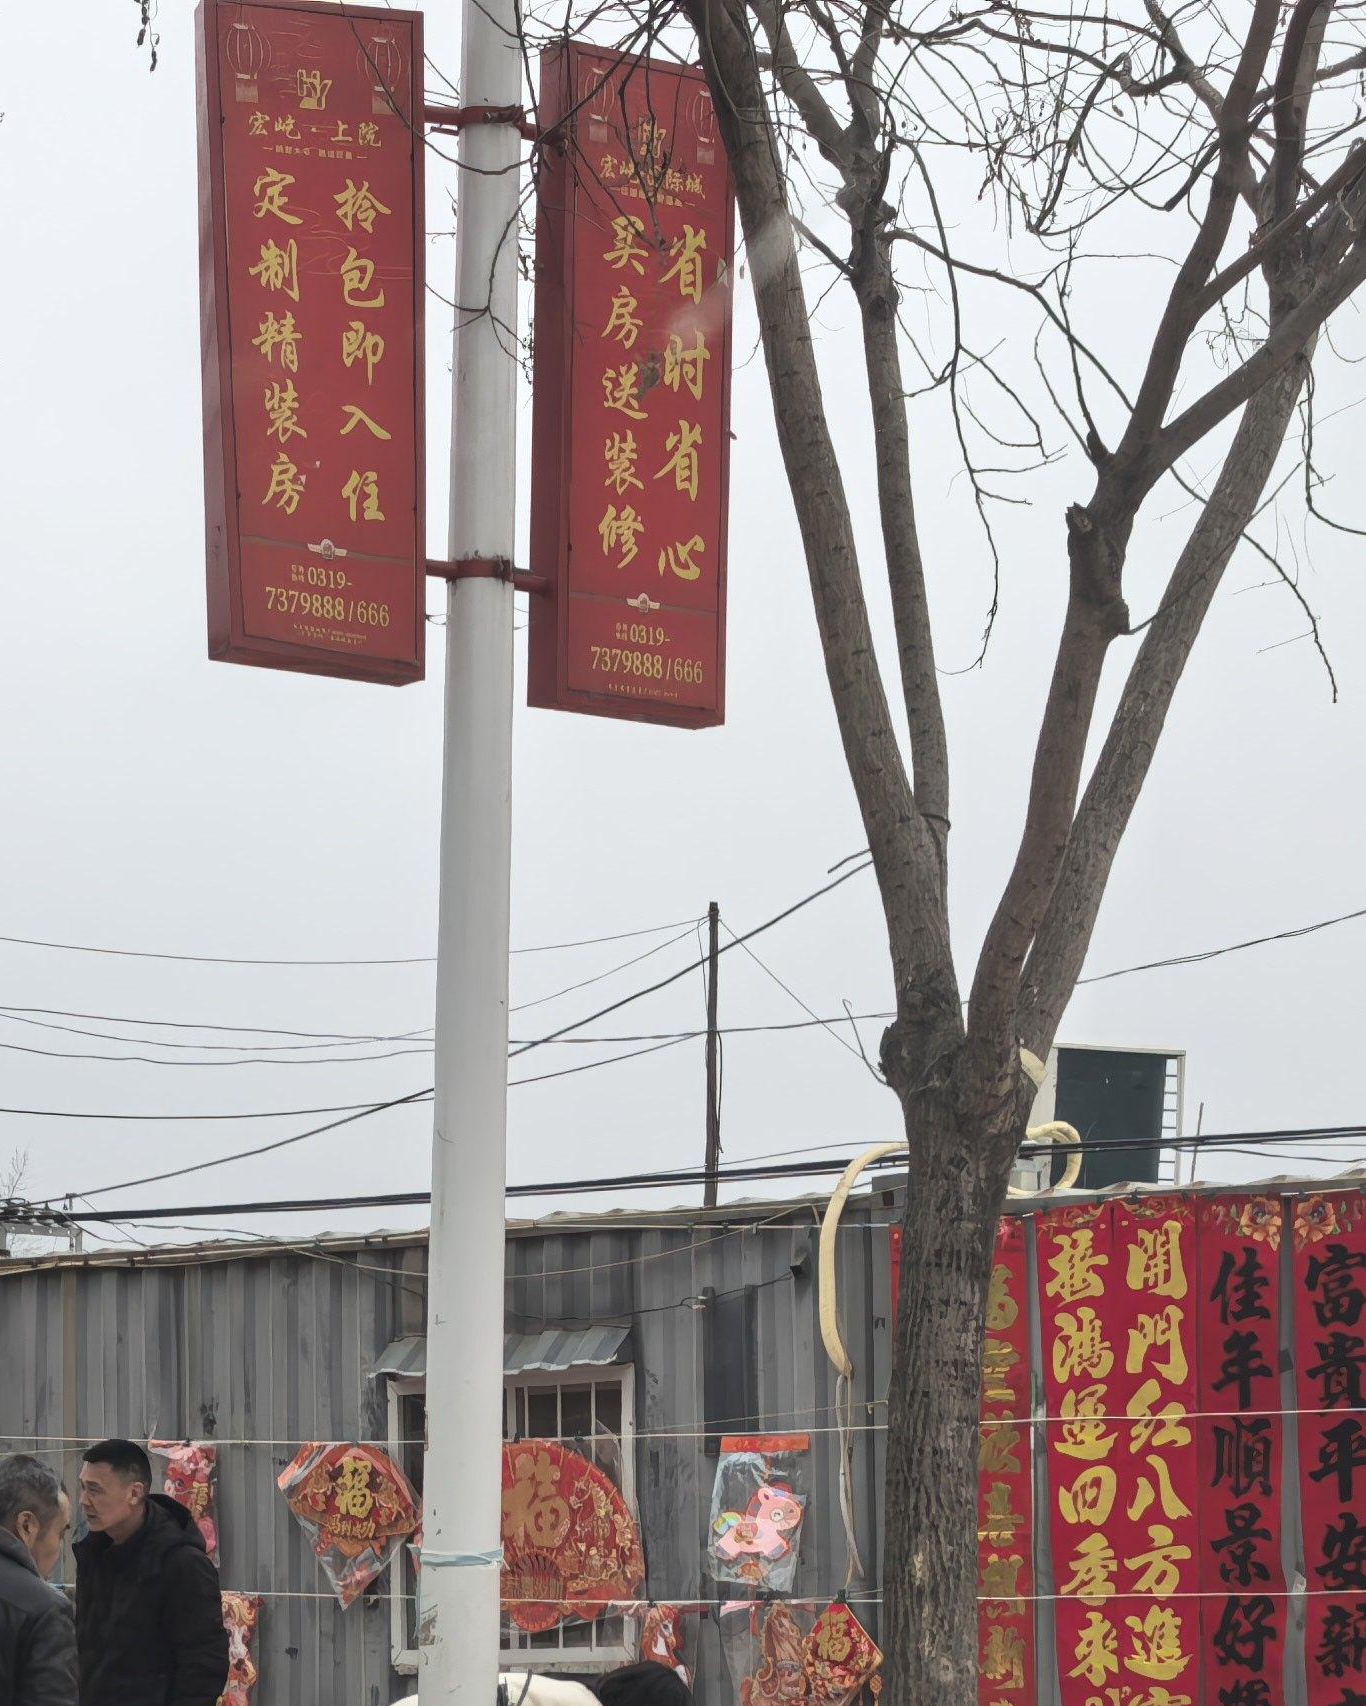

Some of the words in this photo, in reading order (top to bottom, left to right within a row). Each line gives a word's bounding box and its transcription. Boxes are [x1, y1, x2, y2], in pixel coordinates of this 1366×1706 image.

[248, 167, 307, 515] 定制精装房
[333, 178, 392, 522] 拎包即入住
[598, 215, 649, 569] 买房送装修
[653, 224, 710, 581] 省时省心
[265, 586, 390, 627] 7379888/666
[307, 566, 353, 589] 0319-
[590, 645, 703, 684] 7379888/666
[629, 623, 671, 646] 0319-
[335, 1455, 375, 1519] 福
